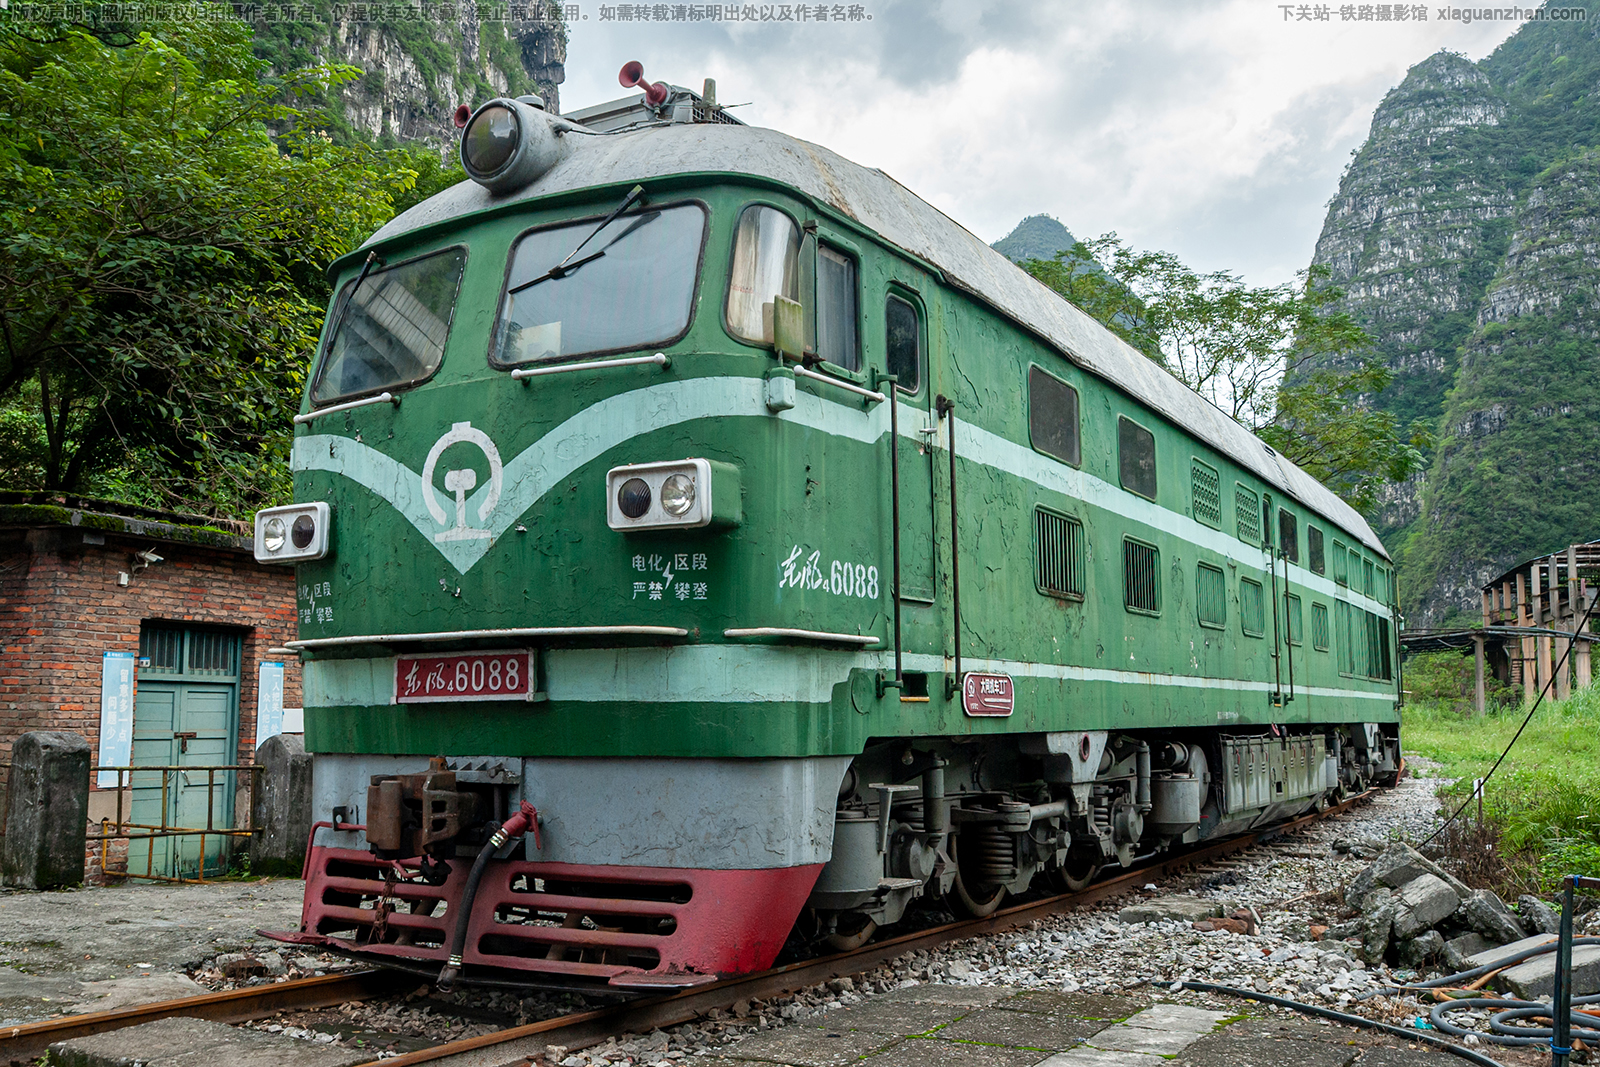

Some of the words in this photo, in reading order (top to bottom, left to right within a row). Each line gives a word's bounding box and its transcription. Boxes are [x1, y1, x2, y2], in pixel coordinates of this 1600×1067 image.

[117, 668, 129, 743] 留意多一点
